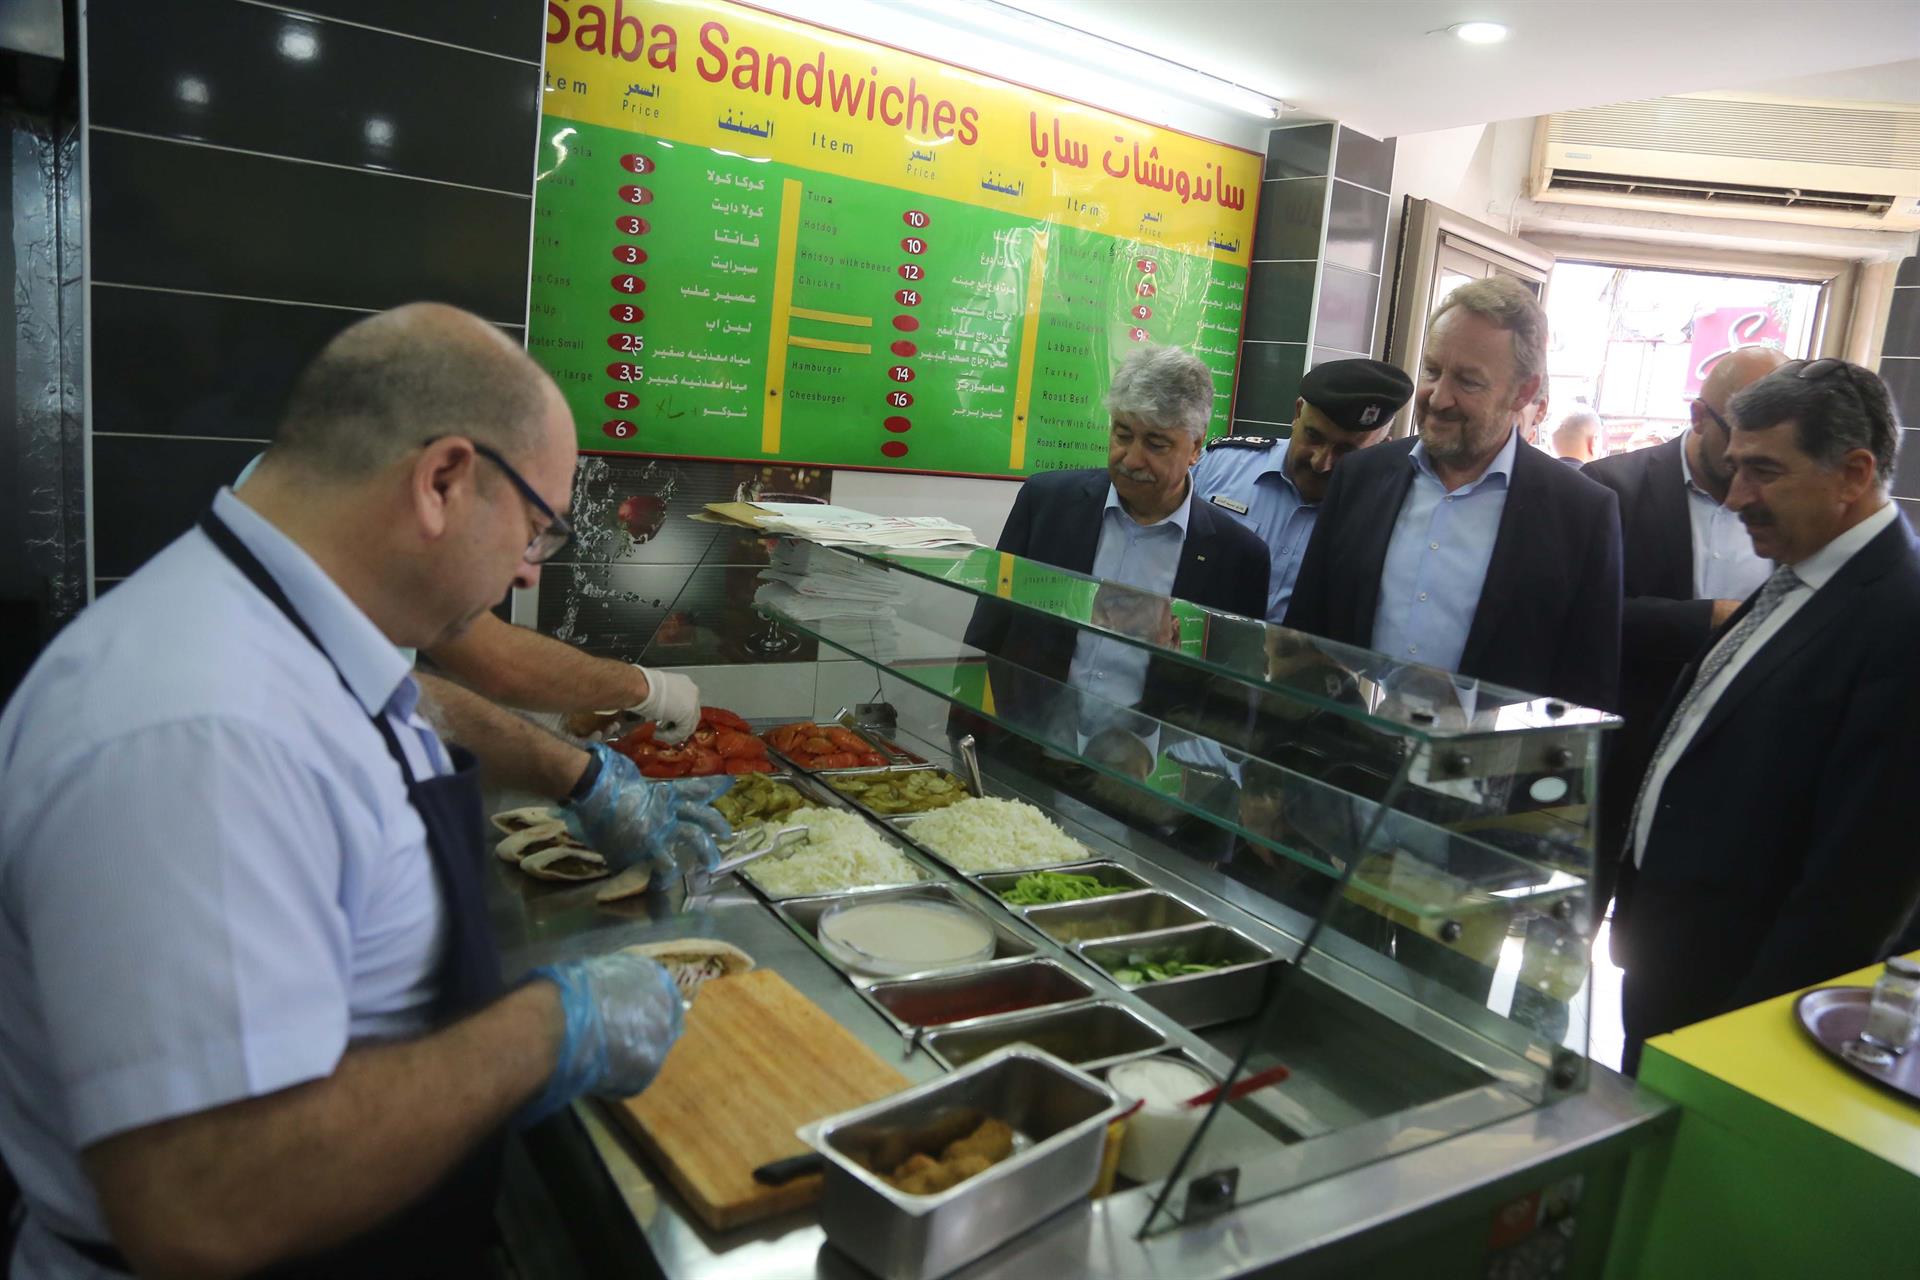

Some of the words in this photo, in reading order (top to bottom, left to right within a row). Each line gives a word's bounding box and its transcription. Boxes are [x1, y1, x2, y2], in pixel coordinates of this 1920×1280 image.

[545, 71, 587, 95] tem
[624, 84, 660, 98] السعر
[697, 22, 979, 146] Sandwiches
[622, 99, 660, 118] Price
[718, 108, 774, 138] الصنف
[812, 132, 854, 155] Item
[1030, 111, 1088, 168] سابا
[909, 150, 936, 162] السعر
[634, 157, 645, 173] 3
[907, 164, 936, 180] Price
[706, 169, 733, 186] كولا
[1103, 136, 1244, 211] ساندوشات
[735, 174, 765, 191] كوكا
[981, 171, 1024, 197] الصنف
[631, 187, 642, 203] 3
[807, 191, 833, 204] Tuna
[711, 197, 738, 216] دايت
[741, 202, 764, 218] كولا
[1067, 198, 1099, 216] Item
[909, 212, 924, 227] 10
[1141, 212, 1162, 223] السعر
[628, 218, 640, 234] 3
[804, 220, 838, 236] Hotdog
[714, 228, 760, 248] فانتا
[1208, 231, 1240, 253] الصنف
[906, 239, 921, 254] 10
[626, 247, 637, 263] 3
[711, 255, 759, 274] سبرايت
[904, 265, 919, 280] 12
[1144, 260, 1152, 273] 5
[623, 277, 634, 292] 4
[1142, 284, 1149, 295] 7
[902, 291, 917, 305] 14
[622, 306, 634, 322] 3
[1139, 307, 1147, 319] 9
[558, 337, 584, 349] Small
[1136, 329, 1144, 341] 9
[792, 360, 842, 375] Hamburger
[895, 367, 909, 381] 14
[617, 393, 629, 409] 5
[893, 393, 908, 407] 16
[615, 421, 627, 437] 6
